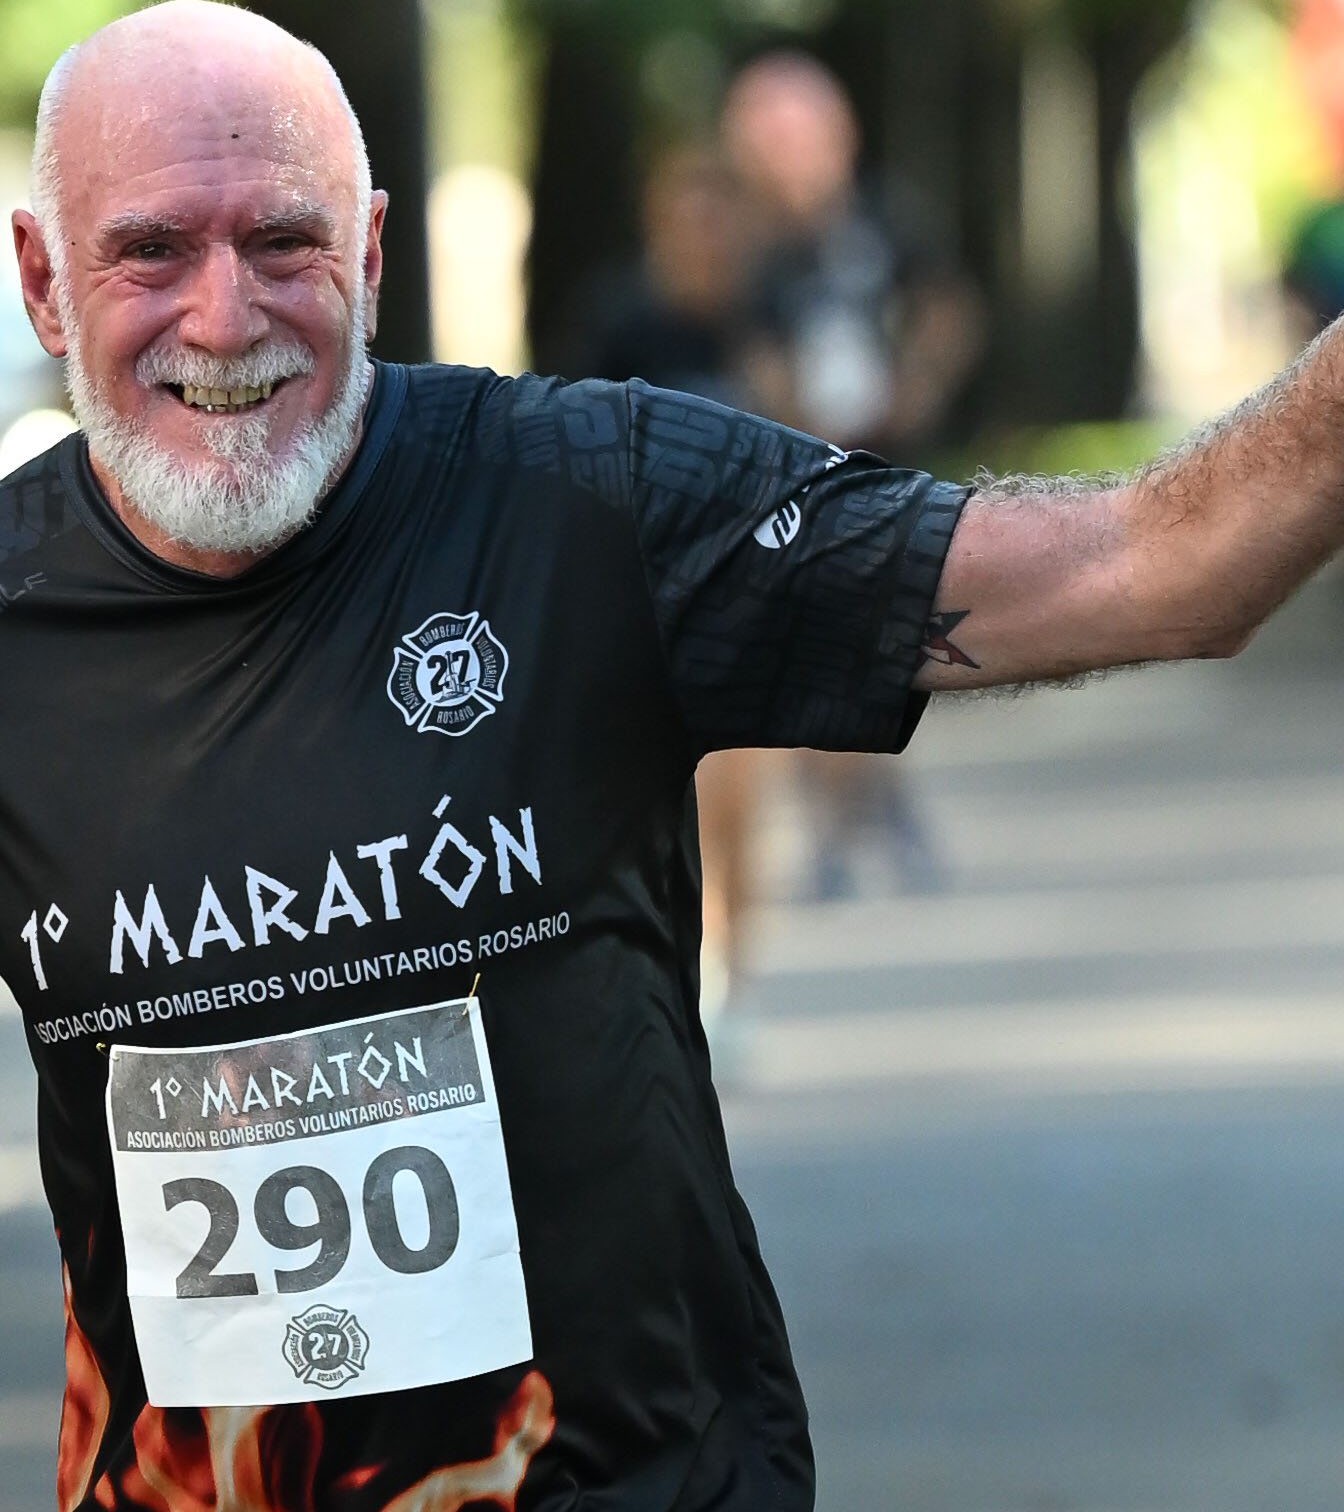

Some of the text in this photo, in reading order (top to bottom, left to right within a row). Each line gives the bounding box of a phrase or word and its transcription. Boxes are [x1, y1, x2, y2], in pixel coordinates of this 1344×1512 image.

[427, 650, 470, 695] 27
[109, 793, 543, 975] MARATÓN
[136, 975, 286, 1024] BOMBEROS
[290, 939, 474, 995] VOLUNTARIOS
[477, 911, 571, 960] ROSARIO
[126, 1082, 477, 1150] ASOCIACIÓN BOMBEROS VOLUNTARIOS ROSARIO
[200, 1031, 429, 1119] MARATÓN
[161, 1145, 460, 1299] 290
[308, 1332, 342, 1361] 27
